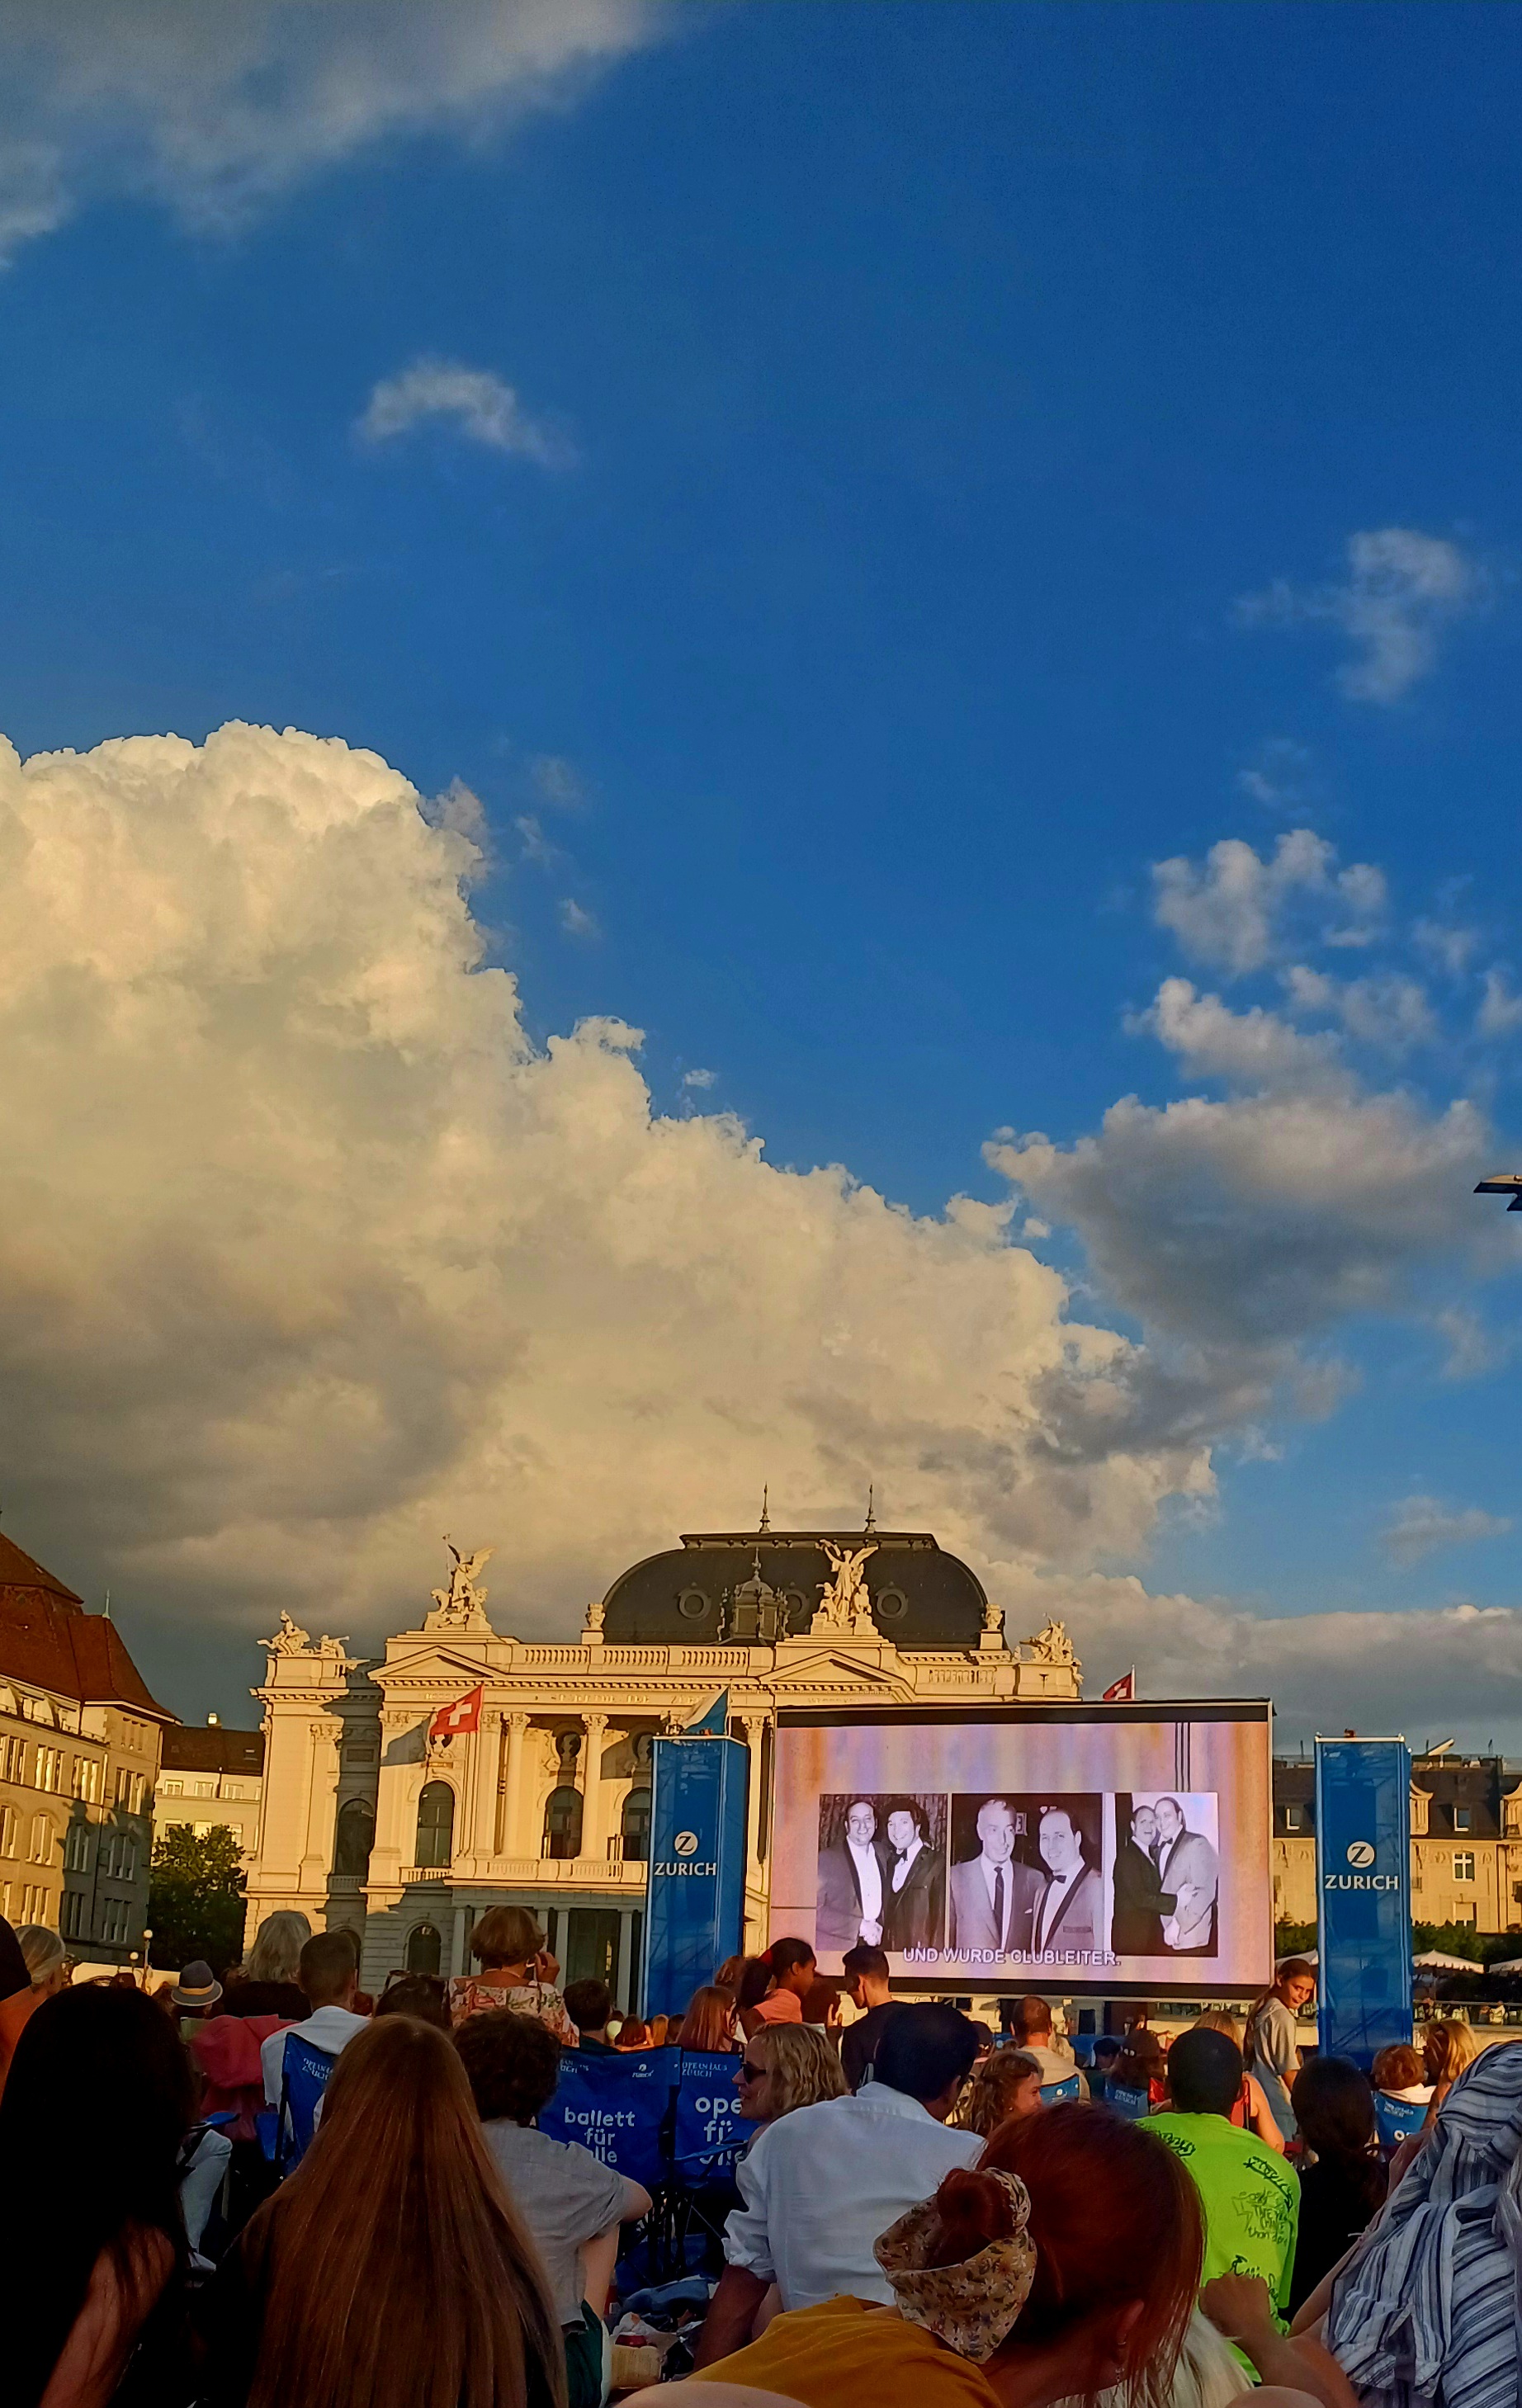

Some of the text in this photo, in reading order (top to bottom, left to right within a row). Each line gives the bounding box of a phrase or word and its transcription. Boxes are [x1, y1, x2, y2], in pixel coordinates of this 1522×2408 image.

[654, 1862, 717, 1876] ZURICH
[1325, 1874, 1399, 1891] ZURICH
[903, 1948, 1122, 1966] UND WURDE CLUBLEITER.
[565, 2106, 636, 2127] ballett
[695, 2097, 743, 2120] ope
[584, 2127, 616, 2146] für
[594, 2146, 617, 2163] lle
